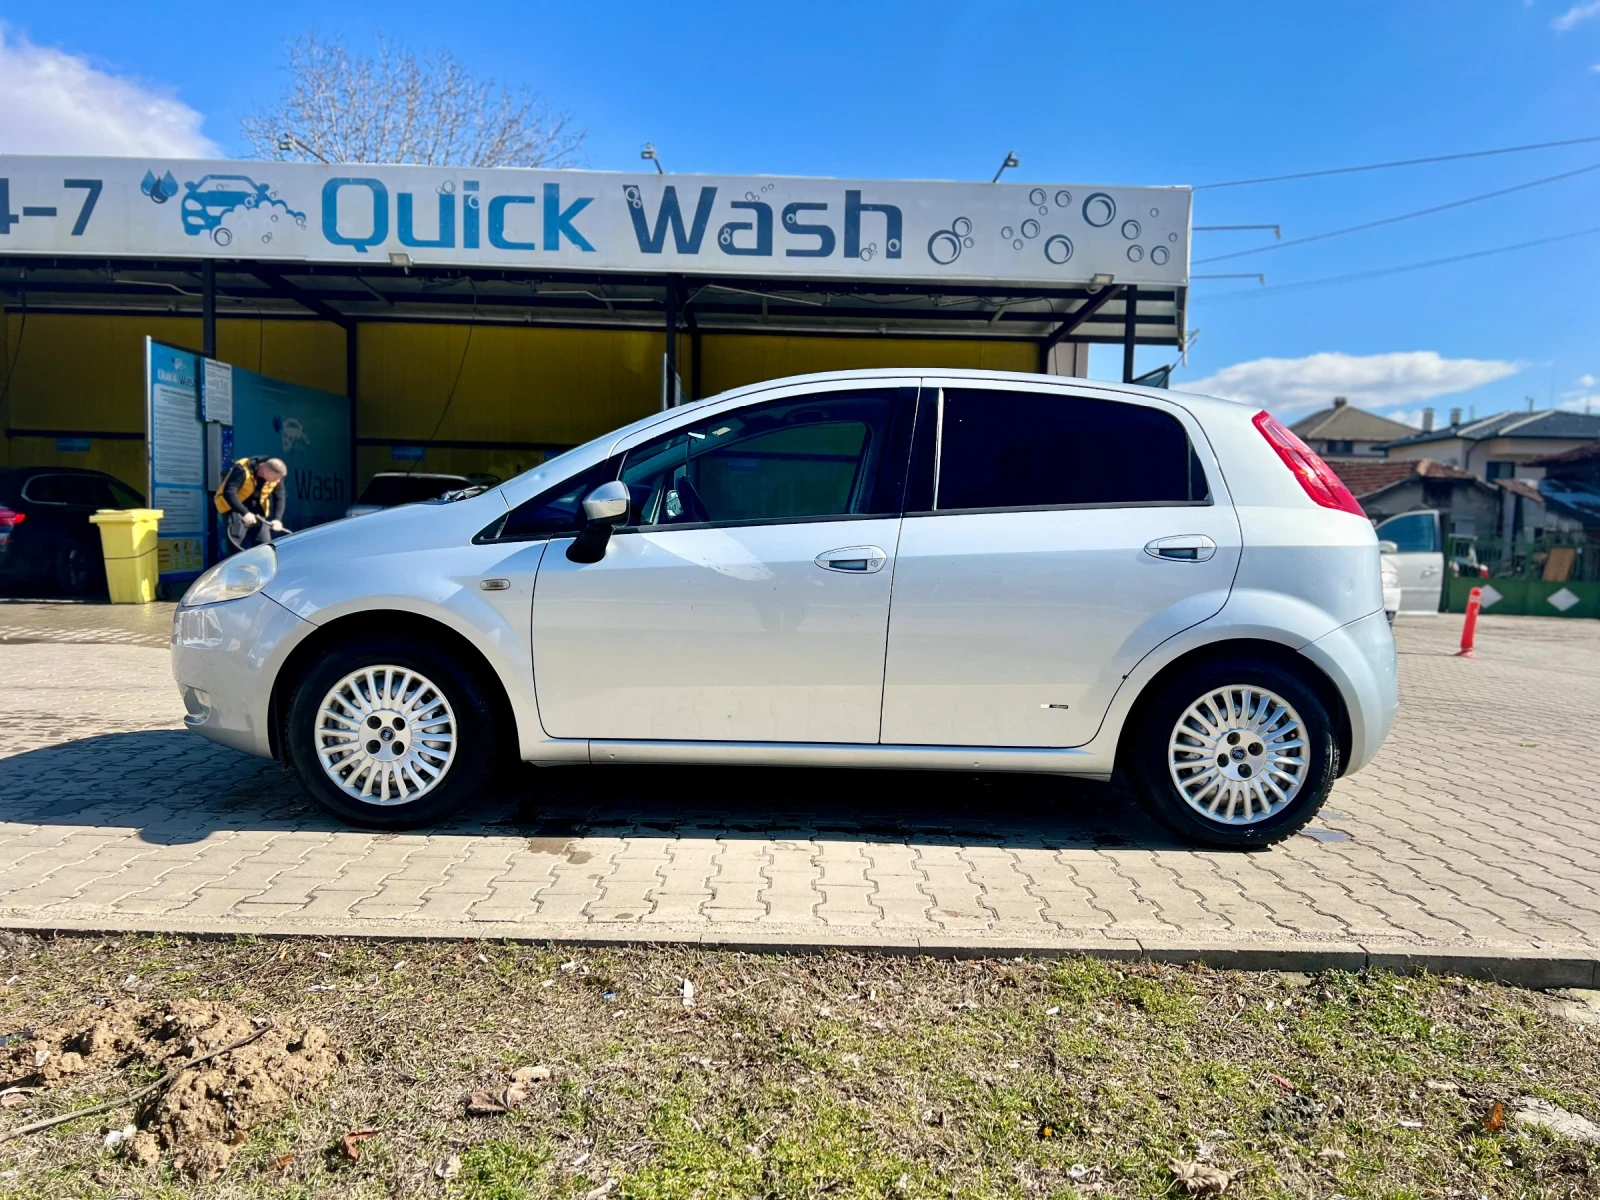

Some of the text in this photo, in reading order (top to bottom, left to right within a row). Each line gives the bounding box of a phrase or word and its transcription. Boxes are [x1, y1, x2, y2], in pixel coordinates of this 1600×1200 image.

[322, 177, 903, 259] Quick Wash
[294, 467, 344, 502] Wash
